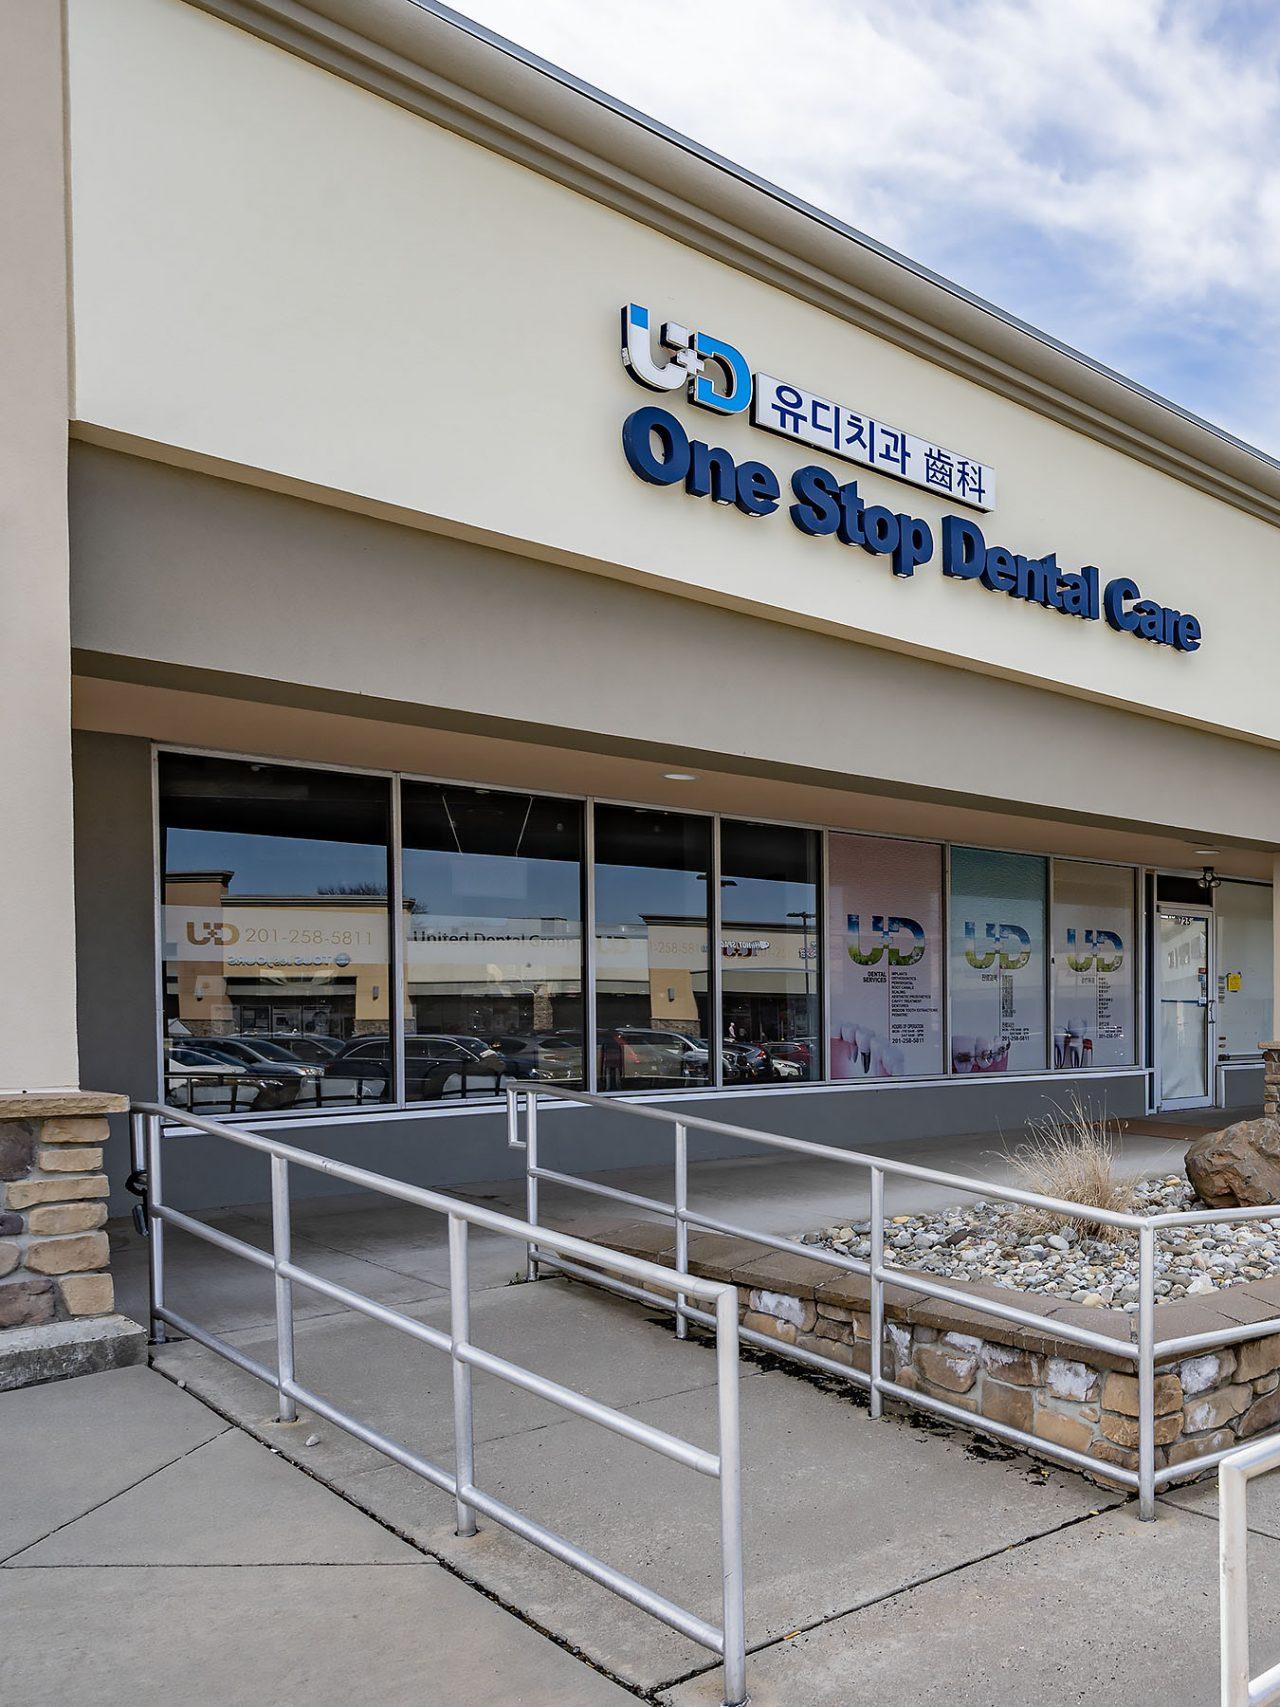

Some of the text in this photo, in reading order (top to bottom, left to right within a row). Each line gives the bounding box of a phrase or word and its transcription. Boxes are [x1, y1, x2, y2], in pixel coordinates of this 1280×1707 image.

[770, 384, 912, 476] 유디치과
[622, 405, 1202, 653] One Stop Dental Care
[245, 928, 374, 945] 201-258-5811
